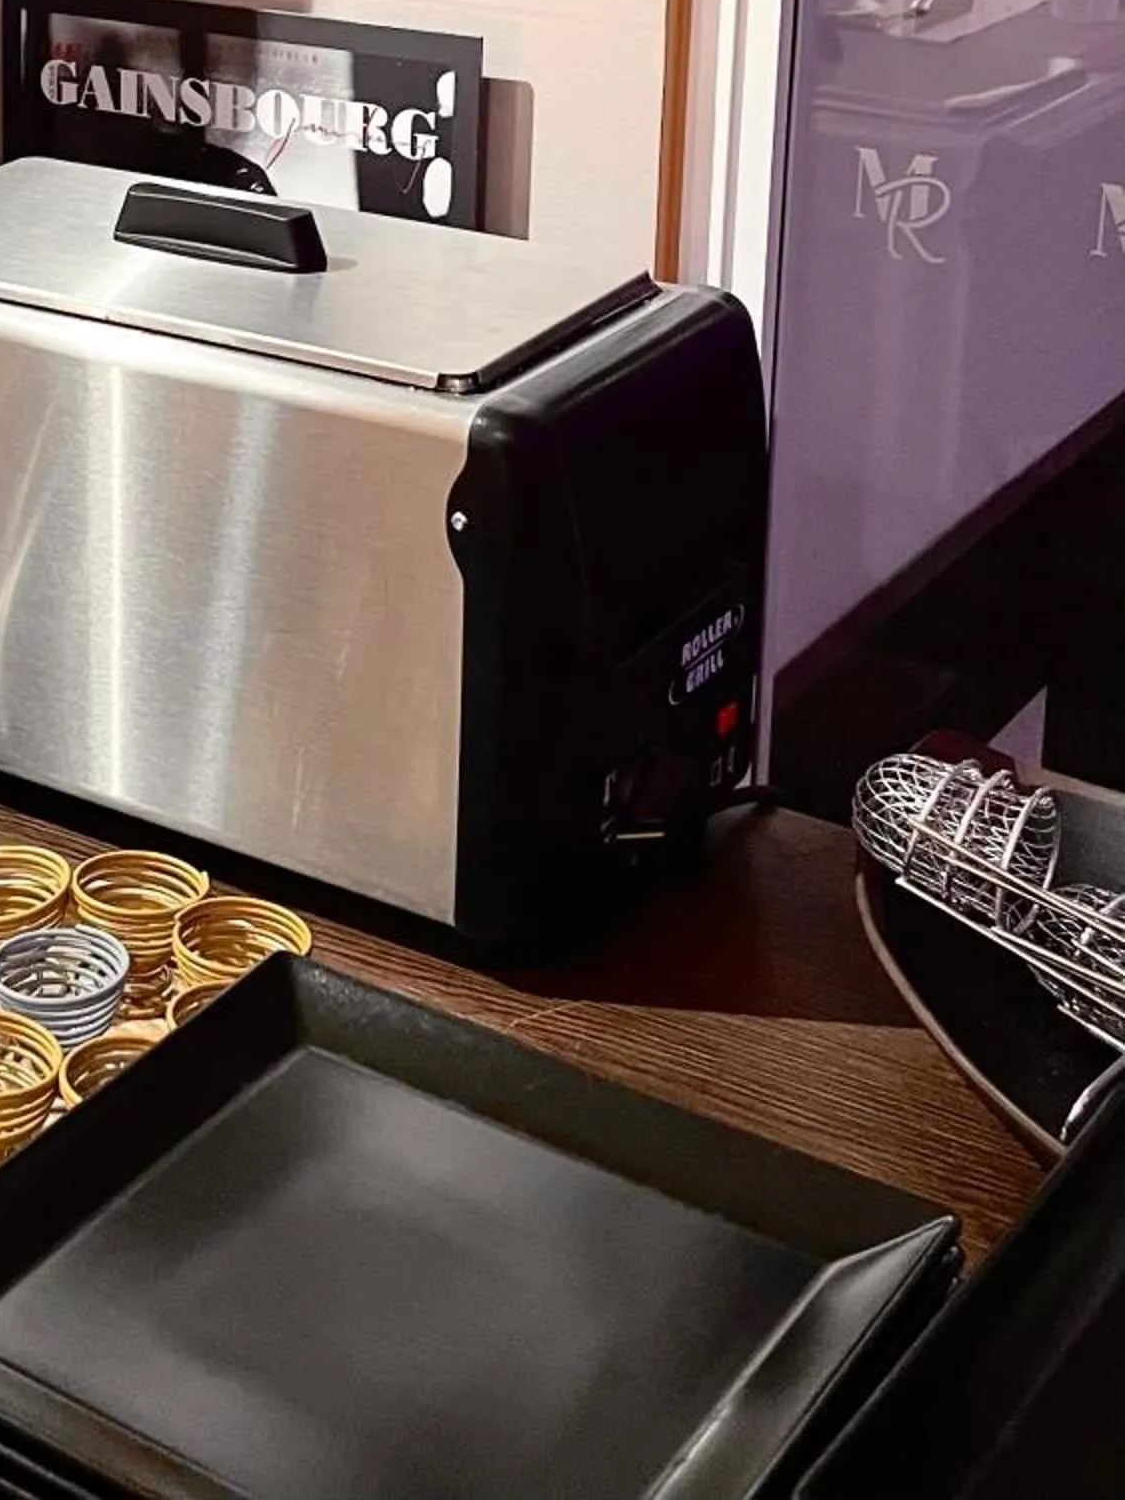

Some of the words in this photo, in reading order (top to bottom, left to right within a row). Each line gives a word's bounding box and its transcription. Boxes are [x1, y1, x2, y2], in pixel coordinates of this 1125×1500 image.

[40, 59, 439, 161] GAINSBOURG
[681, 609, 732, 667] ROLLER
[686, 648, 724, 693] GRILL
